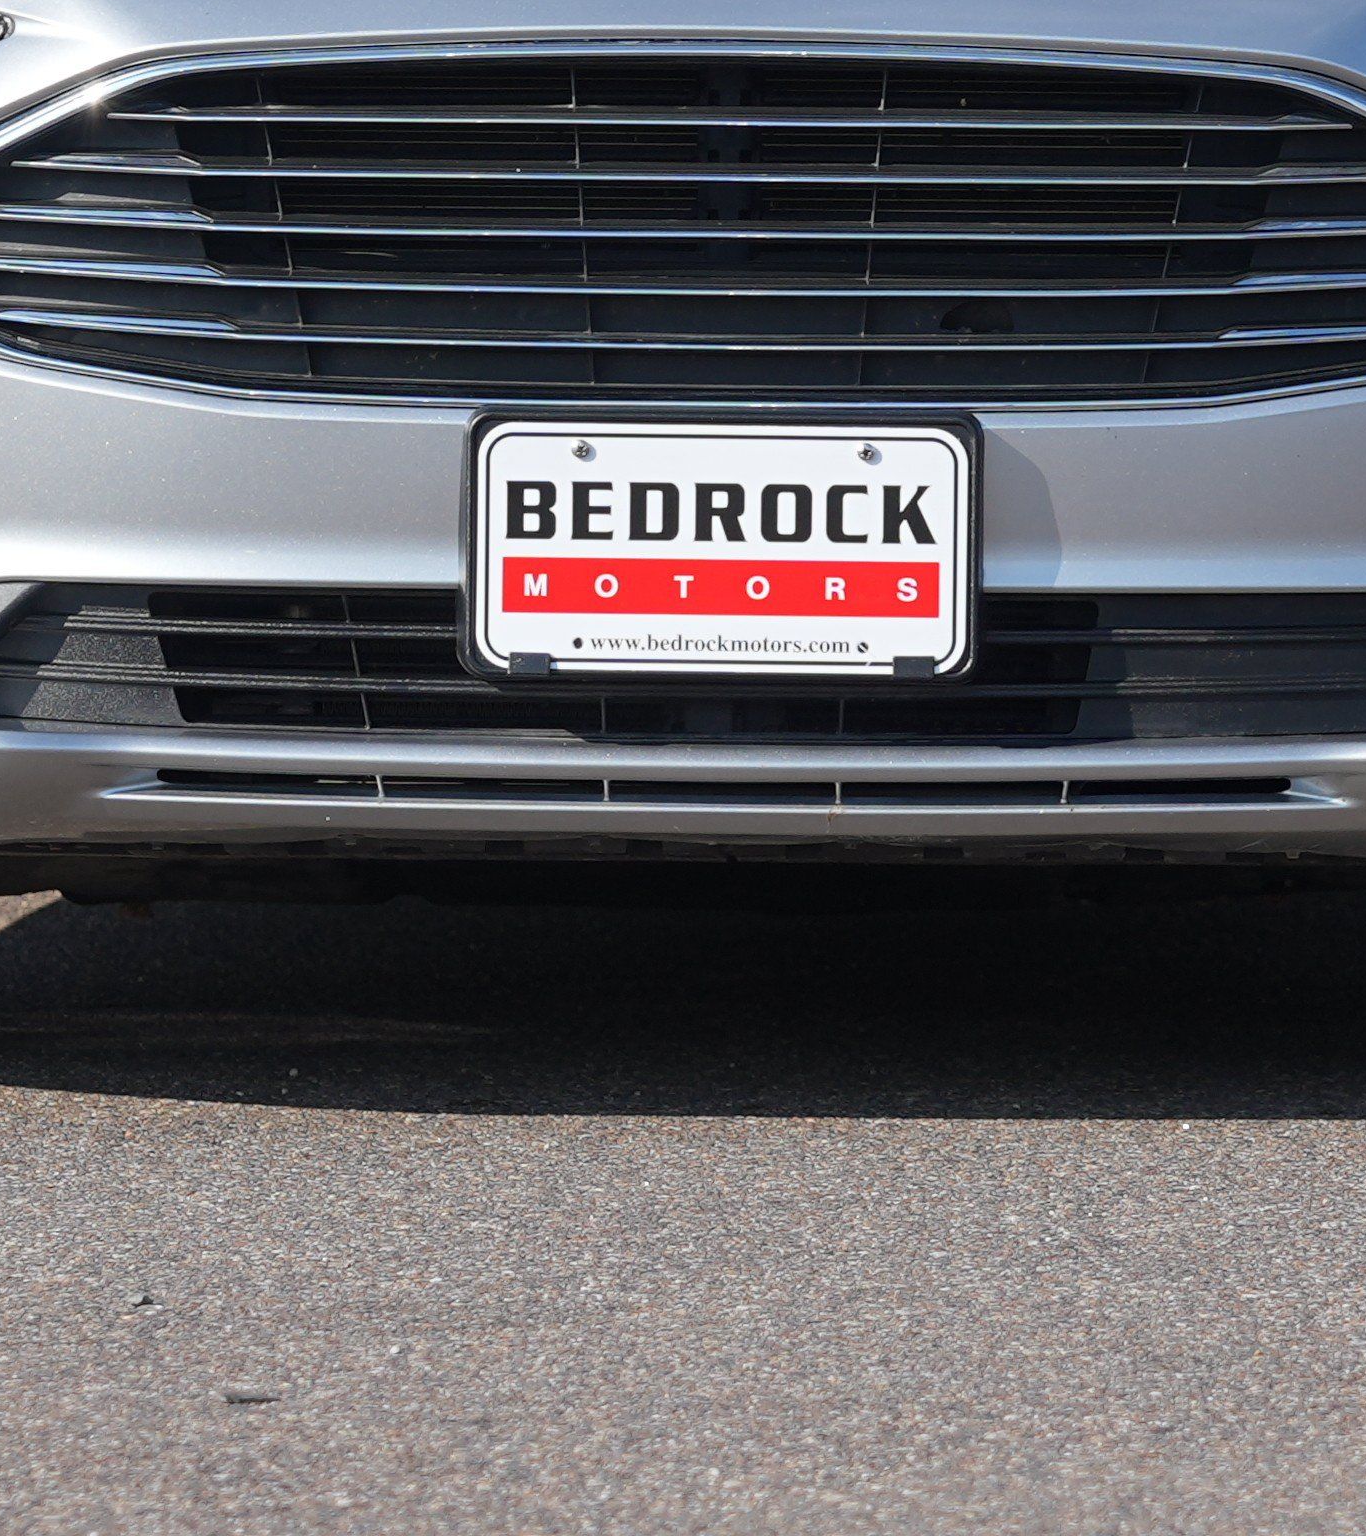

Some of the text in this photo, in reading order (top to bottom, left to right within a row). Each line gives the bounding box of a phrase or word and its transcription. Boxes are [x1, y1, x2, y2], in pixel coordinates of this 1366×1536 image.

[505, 480, 937, 545] BEDROCK
[523, 573, 918, 602] MOTORS
[590, 632, 851, 654] www.bedrockmotors.com
